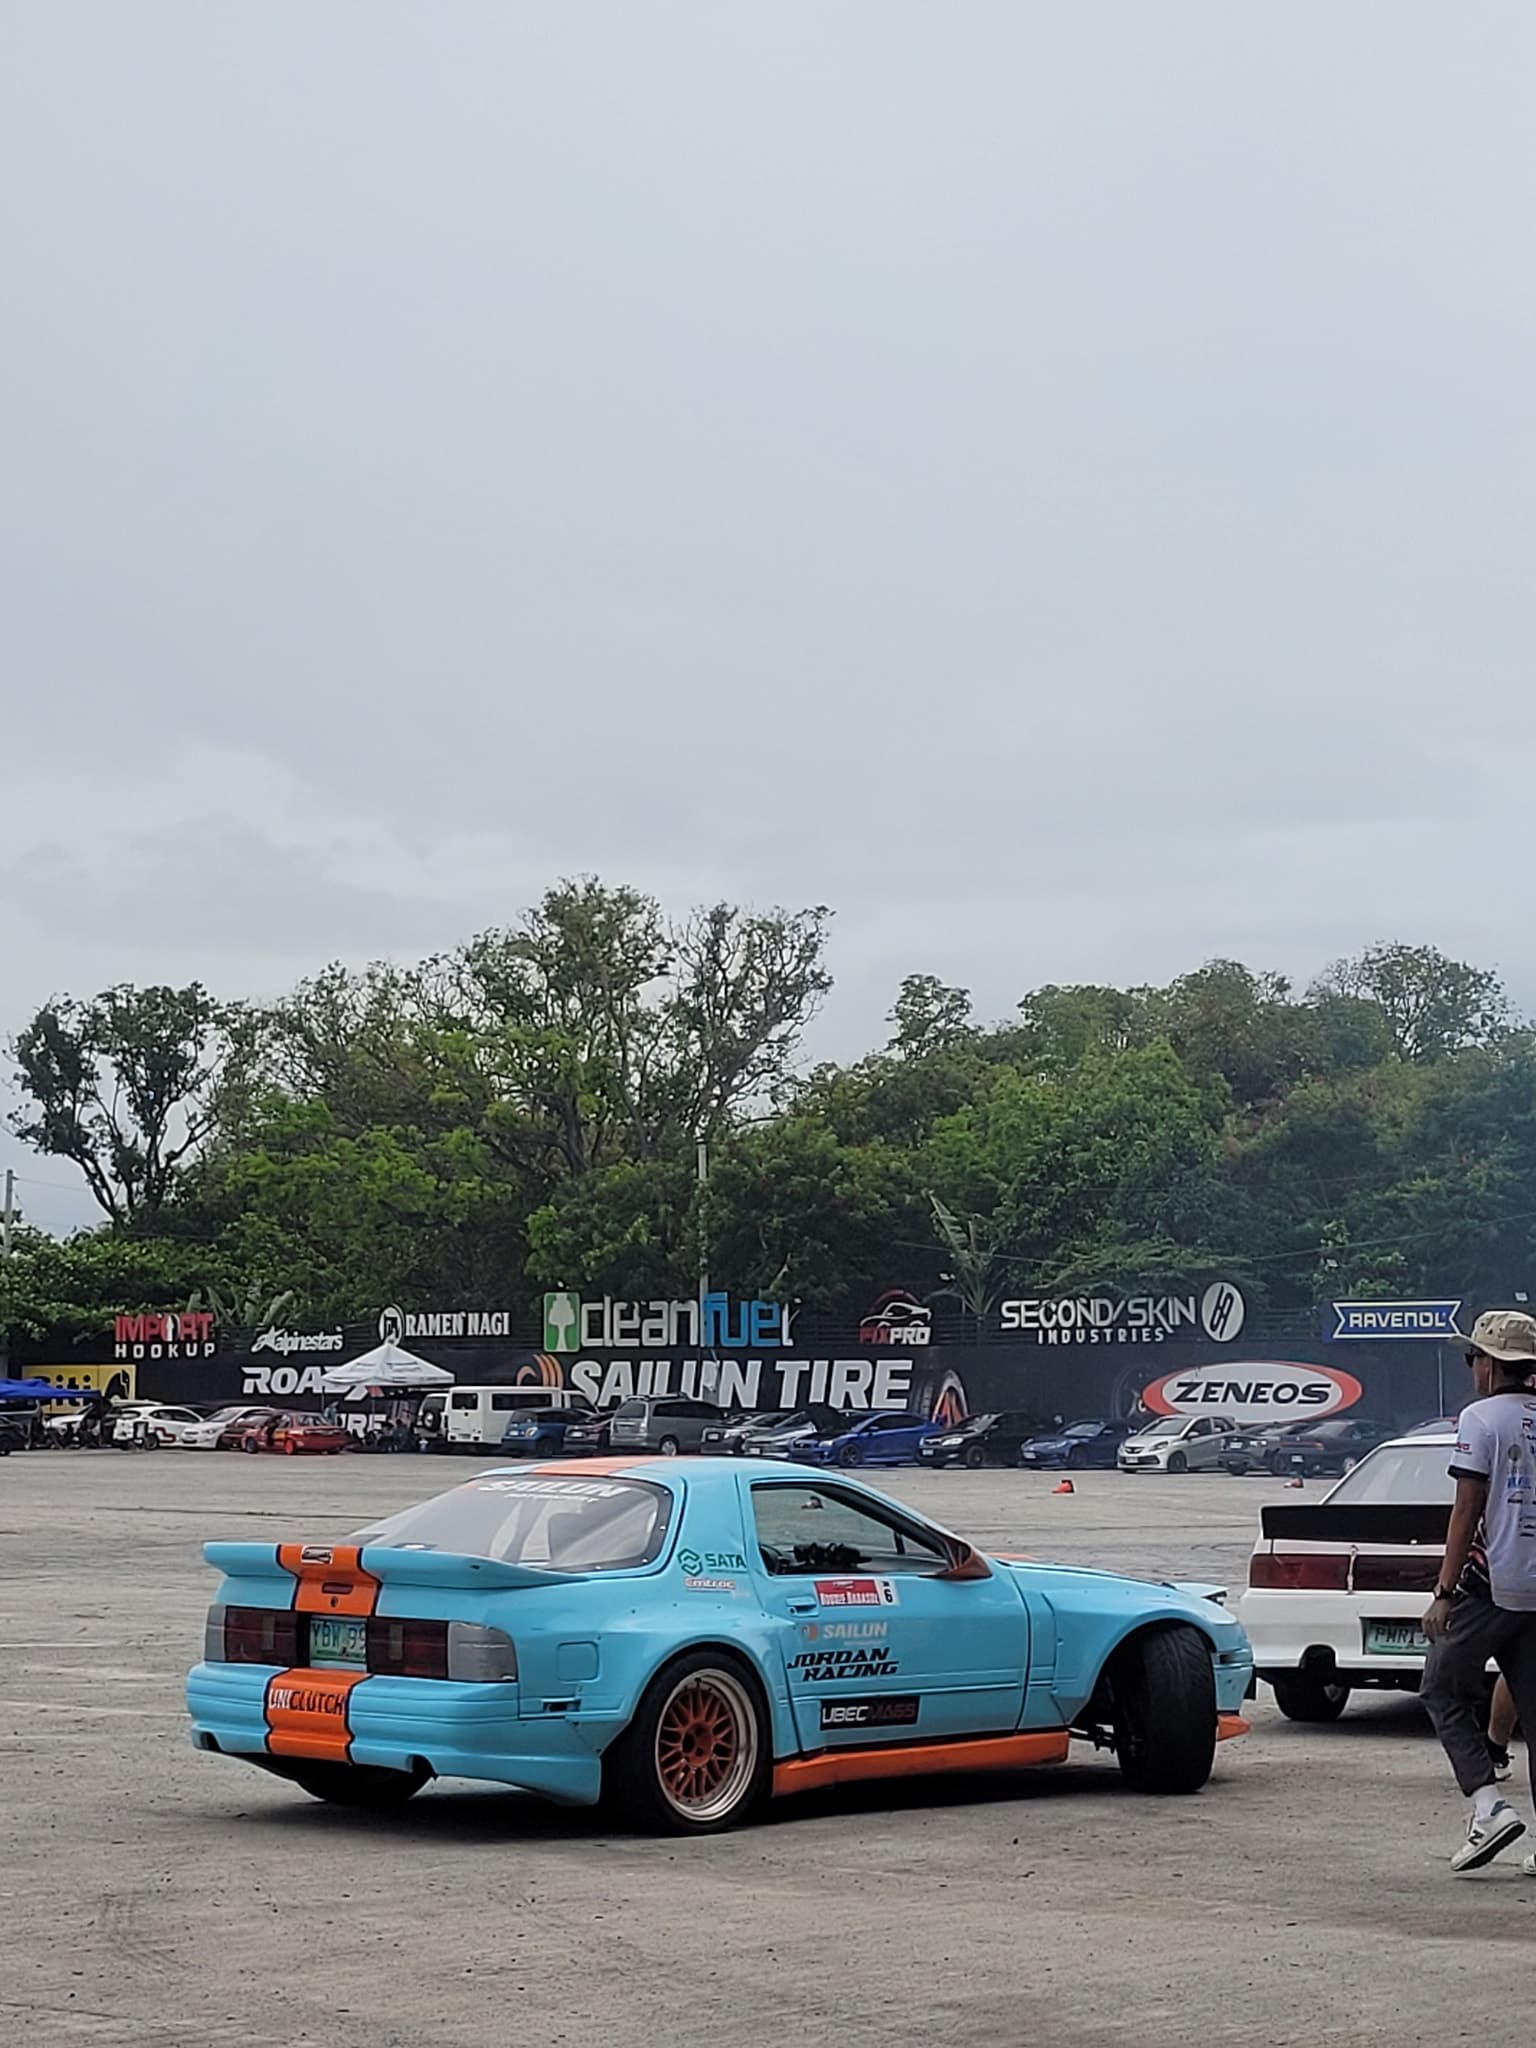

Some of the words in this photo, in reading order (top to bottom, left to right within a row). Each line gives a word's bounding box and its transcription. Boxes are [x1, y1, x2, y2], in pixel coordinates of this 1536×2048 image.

[115, 1313, 214, 1343] IMPORT
[405, 1312, 463, 1336] RAMEN
[467, 1312, 510, 1336] NAGI
[1349, 1312, 1446, 1328] RAVENOL
[1037, 1327, 1165, 1344] INDUSTRIES
[115, 1344, 215, 1359] HOOKUP
[571, 1360, 762, 1408] SAILUN
[775, 1360, 912, 1409] TIRE
[1172, 1381, 1332, 1404] ZENEOS
[704, 1553, 747, 1568] SATA
[883, 1588, 893, 1603] 6
[823, 1621, 887, 1640] SAILUN
[787, 1647, 890, 1669] JORDAN
[803, 1661, 900, 1682] RACING
[268, 1687, 344, 1716] UNICLUTCH
